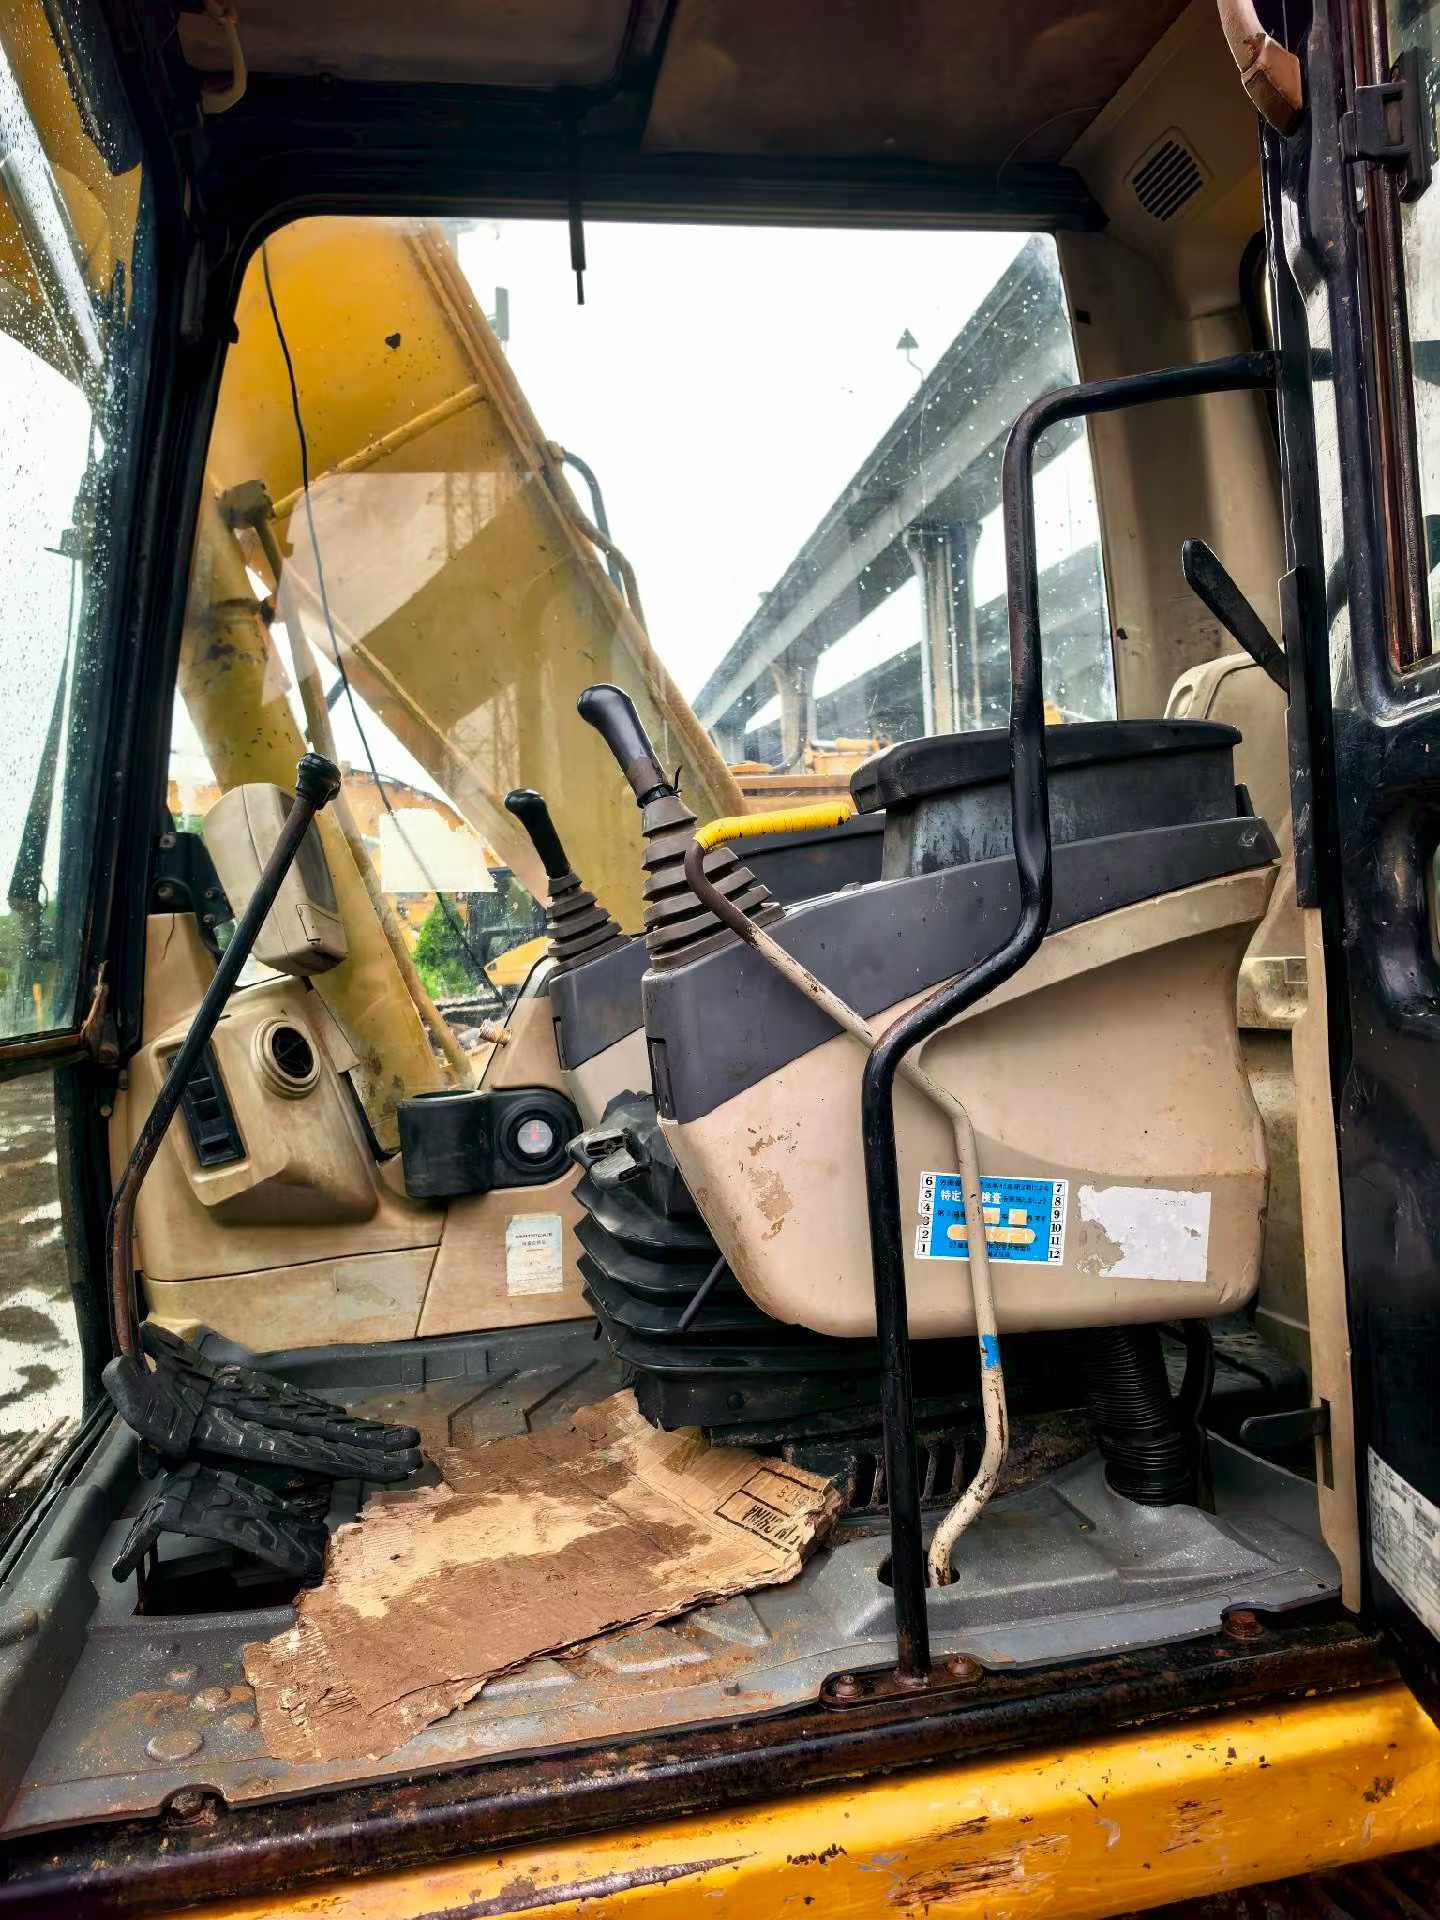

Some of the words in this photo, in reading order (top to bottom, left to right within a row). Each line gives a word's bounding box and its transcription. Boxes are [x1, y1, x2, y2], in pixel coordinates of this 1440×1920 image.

[925, 1176, 933, 1185] 6
[1056, 1184, 1062, 1193] 7
[924, 1190, 932, 1199] 5
[1054, 1196, 1061, 1206] 8
[923, 1203, 931, 1212] 4
[1054, 1210, 1060, 1219] 9
[922, 1216, 930, 1226] 3
[1051, 1223, 1062, 1233] 10
[921, 1230, 929, 1239] 2
[1051, 1236, 1059, 1245] 11
[921, 1243, 926, 1252] 1
[1049, 1250, 1060, 1259] 12
